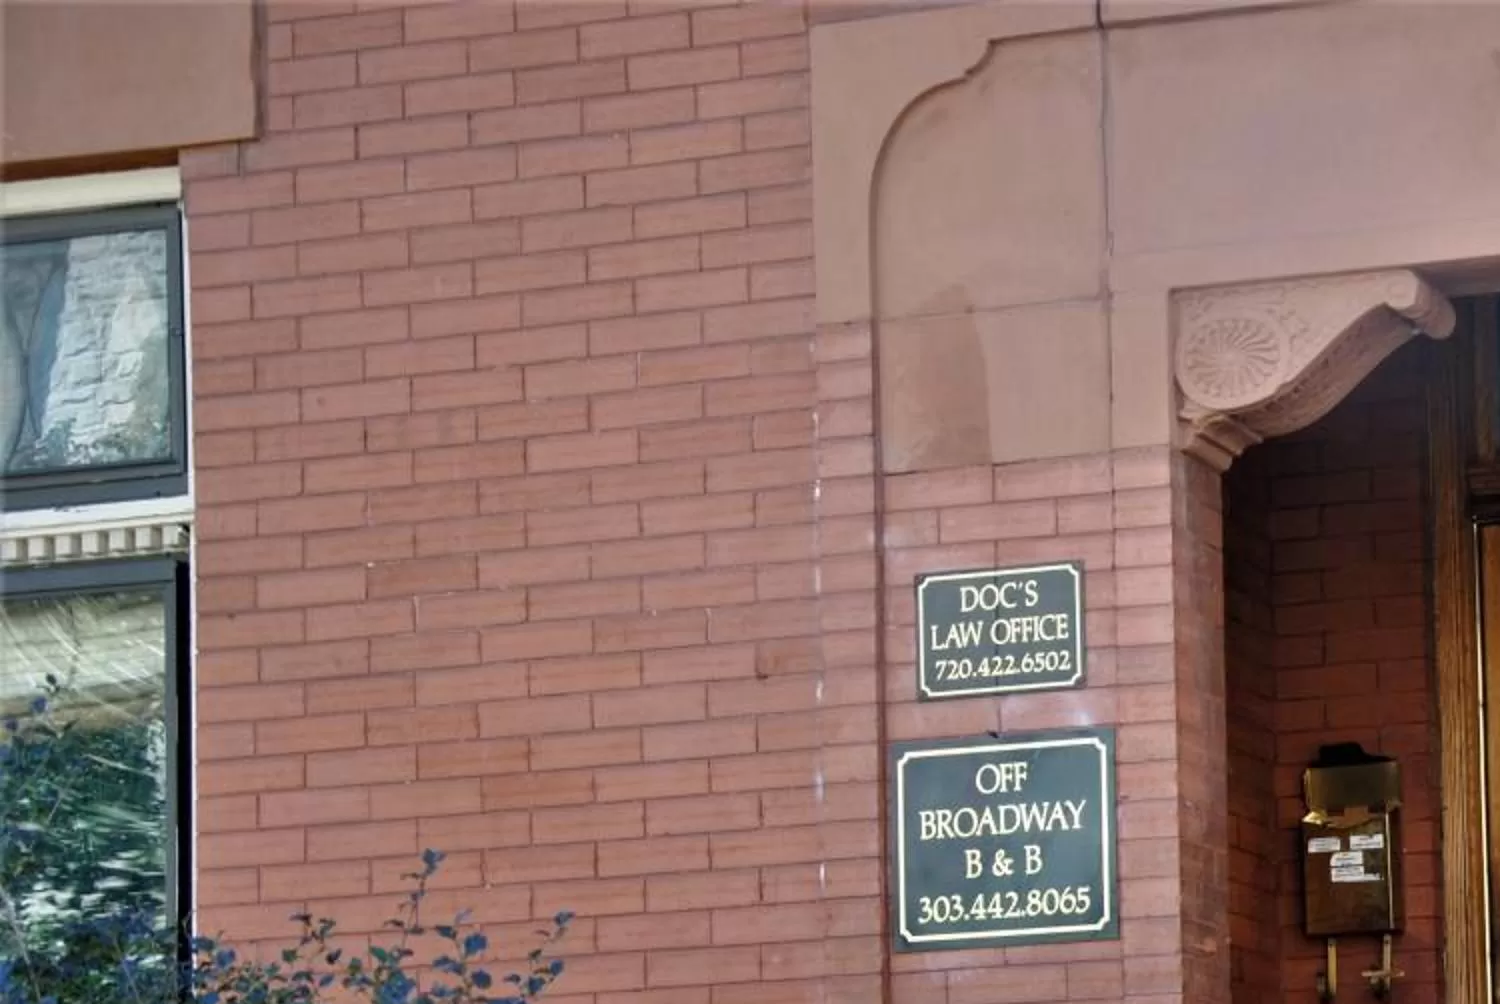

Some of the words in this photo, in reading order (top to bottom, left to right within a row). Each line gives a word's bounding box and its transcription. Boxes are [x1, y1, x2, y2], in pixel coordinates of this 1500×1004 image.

[960, 580, 1039, 612] DOC'S
[931, 621, 984, 650] LAW
[990, 613, 1069, 645] OFFICE
[935, 650, 1071, 681] 720.422.6502
[975, 761, 1028, 794] OFF
[918, 800, 1087, 840] BROADWAY
[965, 849, 983, 879] B
[992, 849, 1014, 877] &
[1024, 845, 1043, 874] B
[918, 886, 1091, 924] 303.442.8065
